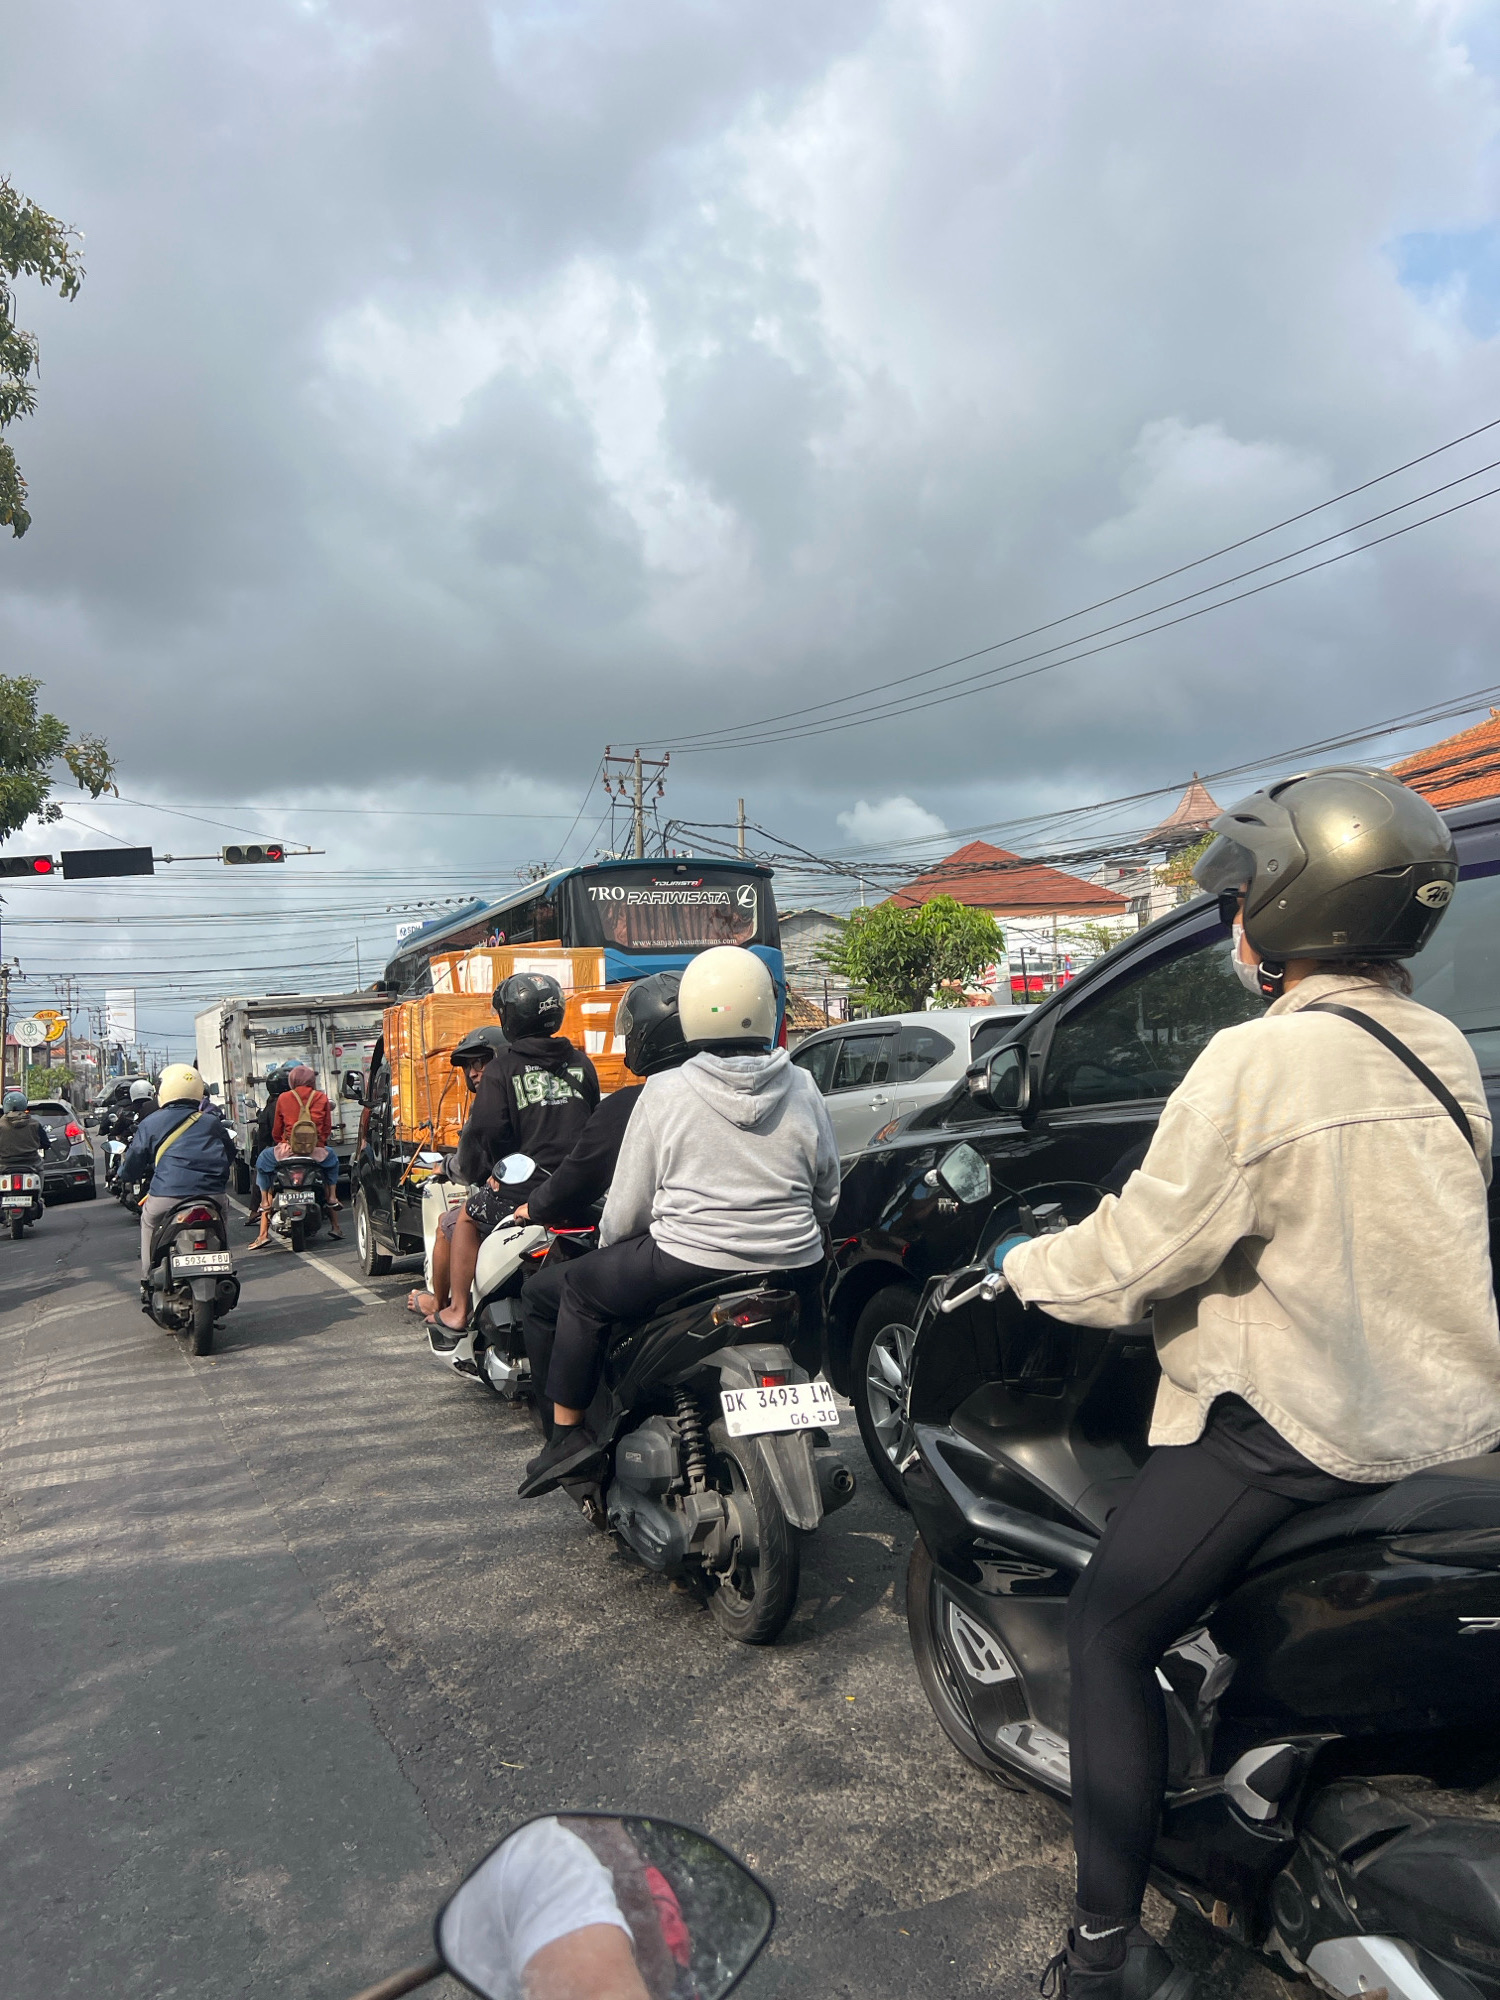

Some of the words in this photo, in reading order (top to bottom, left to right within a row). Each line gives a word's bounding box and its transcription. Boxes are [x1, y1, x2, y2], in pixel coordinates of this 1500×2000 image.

[653, 879, 702, 887] TOURISTA
[588, 886, 625, 901] 7RO
[627, 891, 731, 905] PARIWISATA
[632, 937, 737, 948] www.sanjayakusumatrans.com
[503, 1228, 526, 1245] PCX
[174, 1258, 181, 1267] B
[185, 1255, 207, 1266] 5934
[211, 1253, 229, 1263] FBU
[724, 1392, 747, 1412] DK
[757, 1387, 800, 1408] 3493
[810, 1384, 833, 1403] IM
